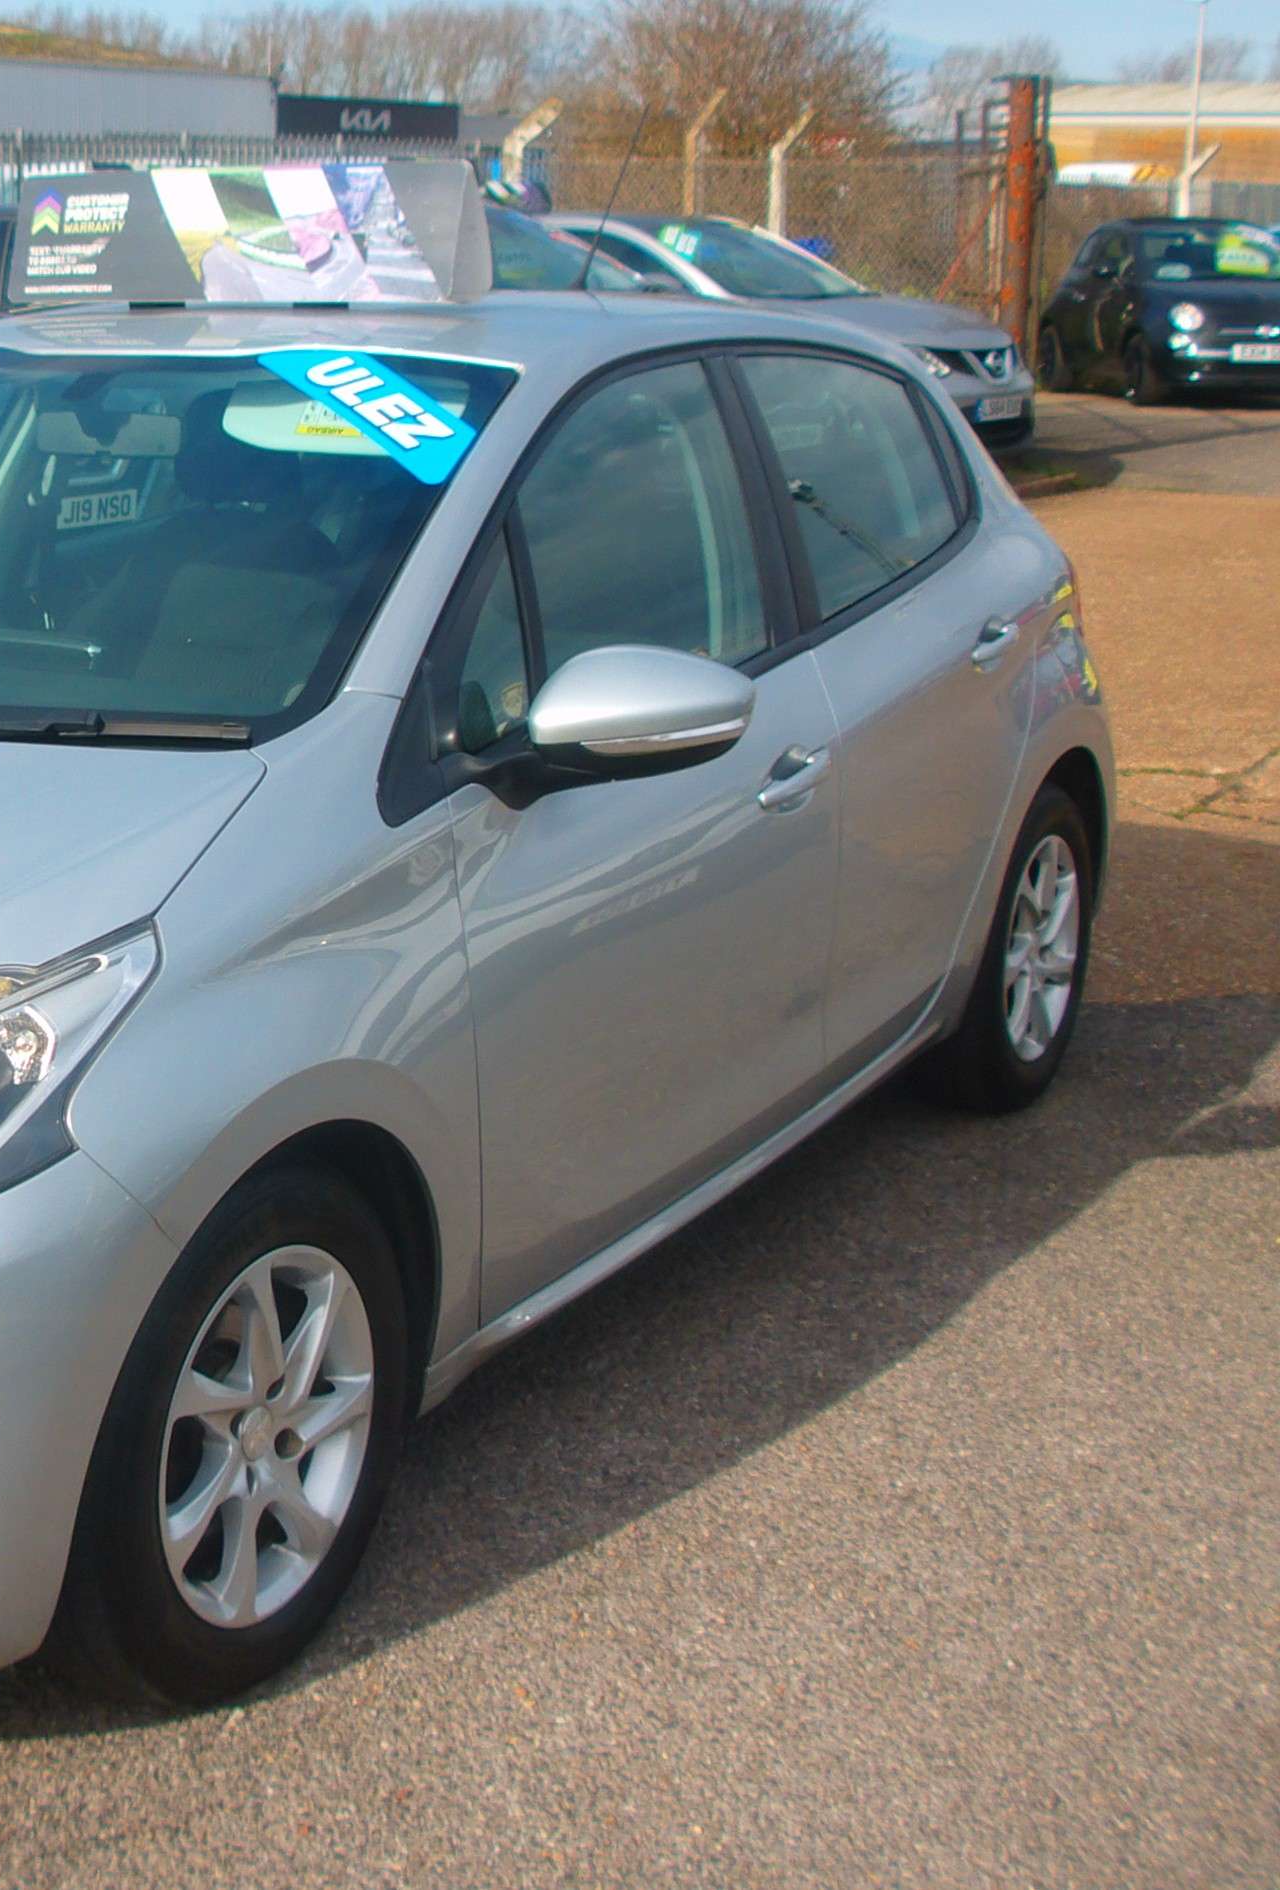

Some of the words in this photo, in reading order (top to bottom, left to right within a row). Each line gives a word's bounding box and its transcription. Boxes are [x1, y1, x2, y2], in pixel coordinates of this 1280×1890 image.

[341, 107, 391, 130] KIA
[66, 192, 130, 208] CUSTOMER
[63, 206, 128, 222] PROTECT
[63, 219, 126, 233] WARRANTY
[306, 356, 455, 449] ULEZ
[63, 499, 92, 524] J19
